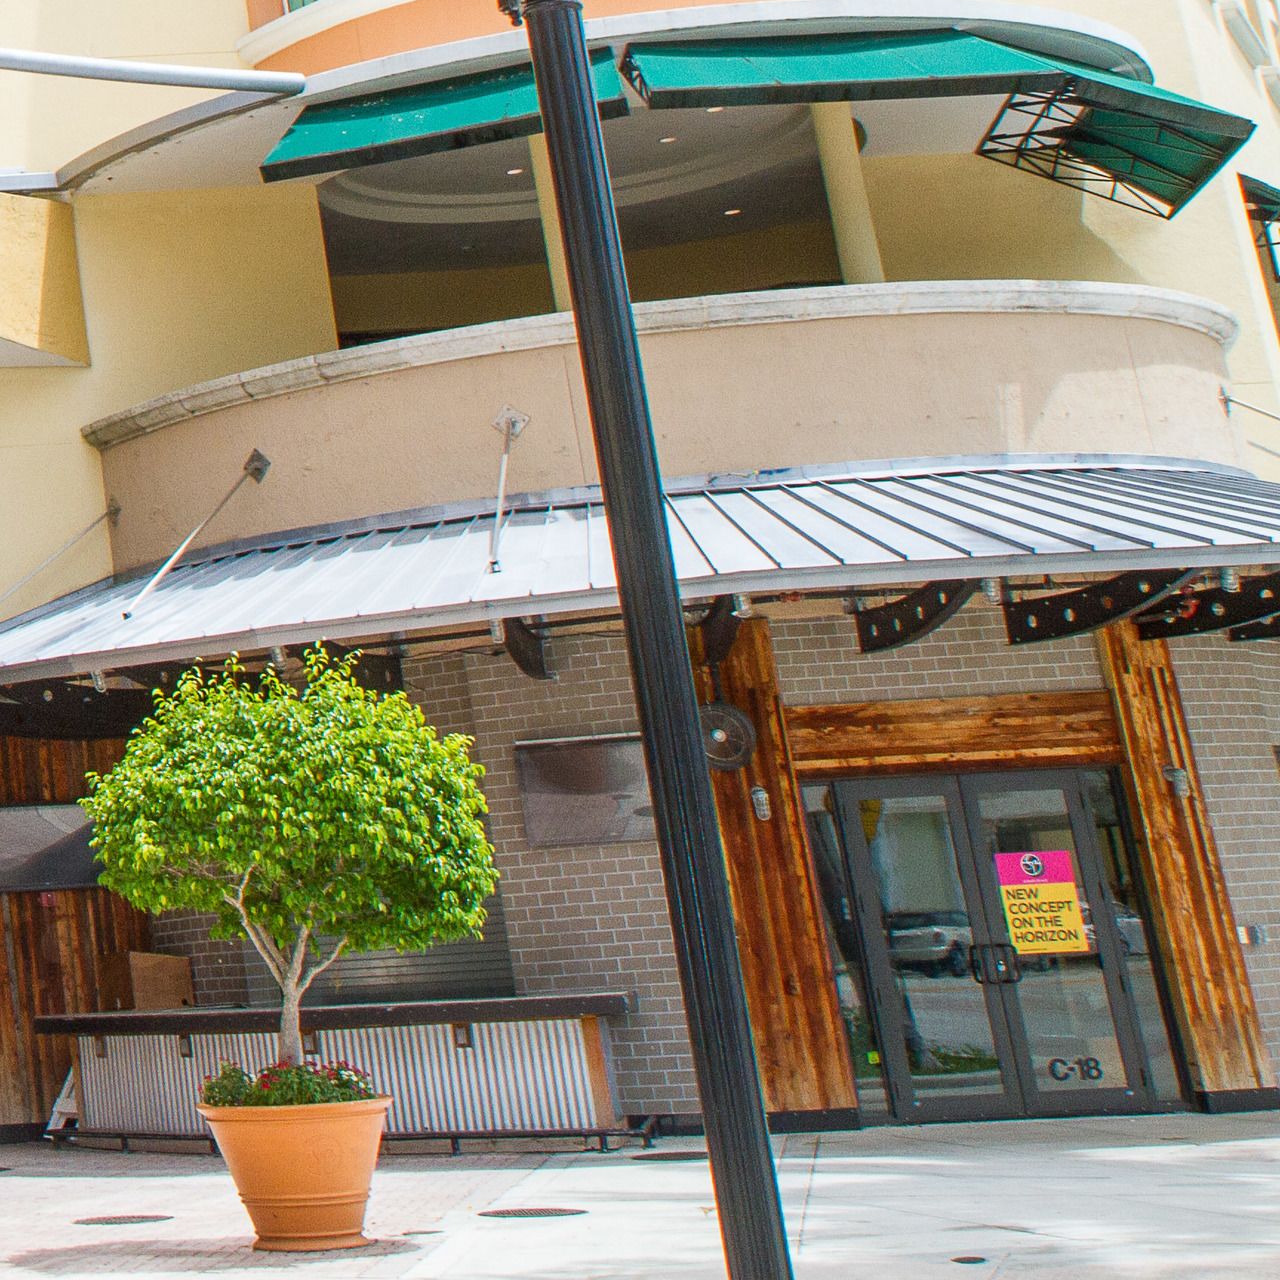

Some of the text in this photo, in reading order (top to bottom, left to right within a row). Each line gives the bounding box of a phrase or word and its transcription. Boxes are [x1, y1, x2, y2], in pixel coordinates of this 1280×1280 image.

[1006, 888, 1038, 900] NEW
[1009, 901, 1072, 914] CONCEPT
[1012, 915, 1063, 929] ON THE
[1014, 929, 1079, 943] HORIZON
[1048, 1056, 1103, 1081] C-18
